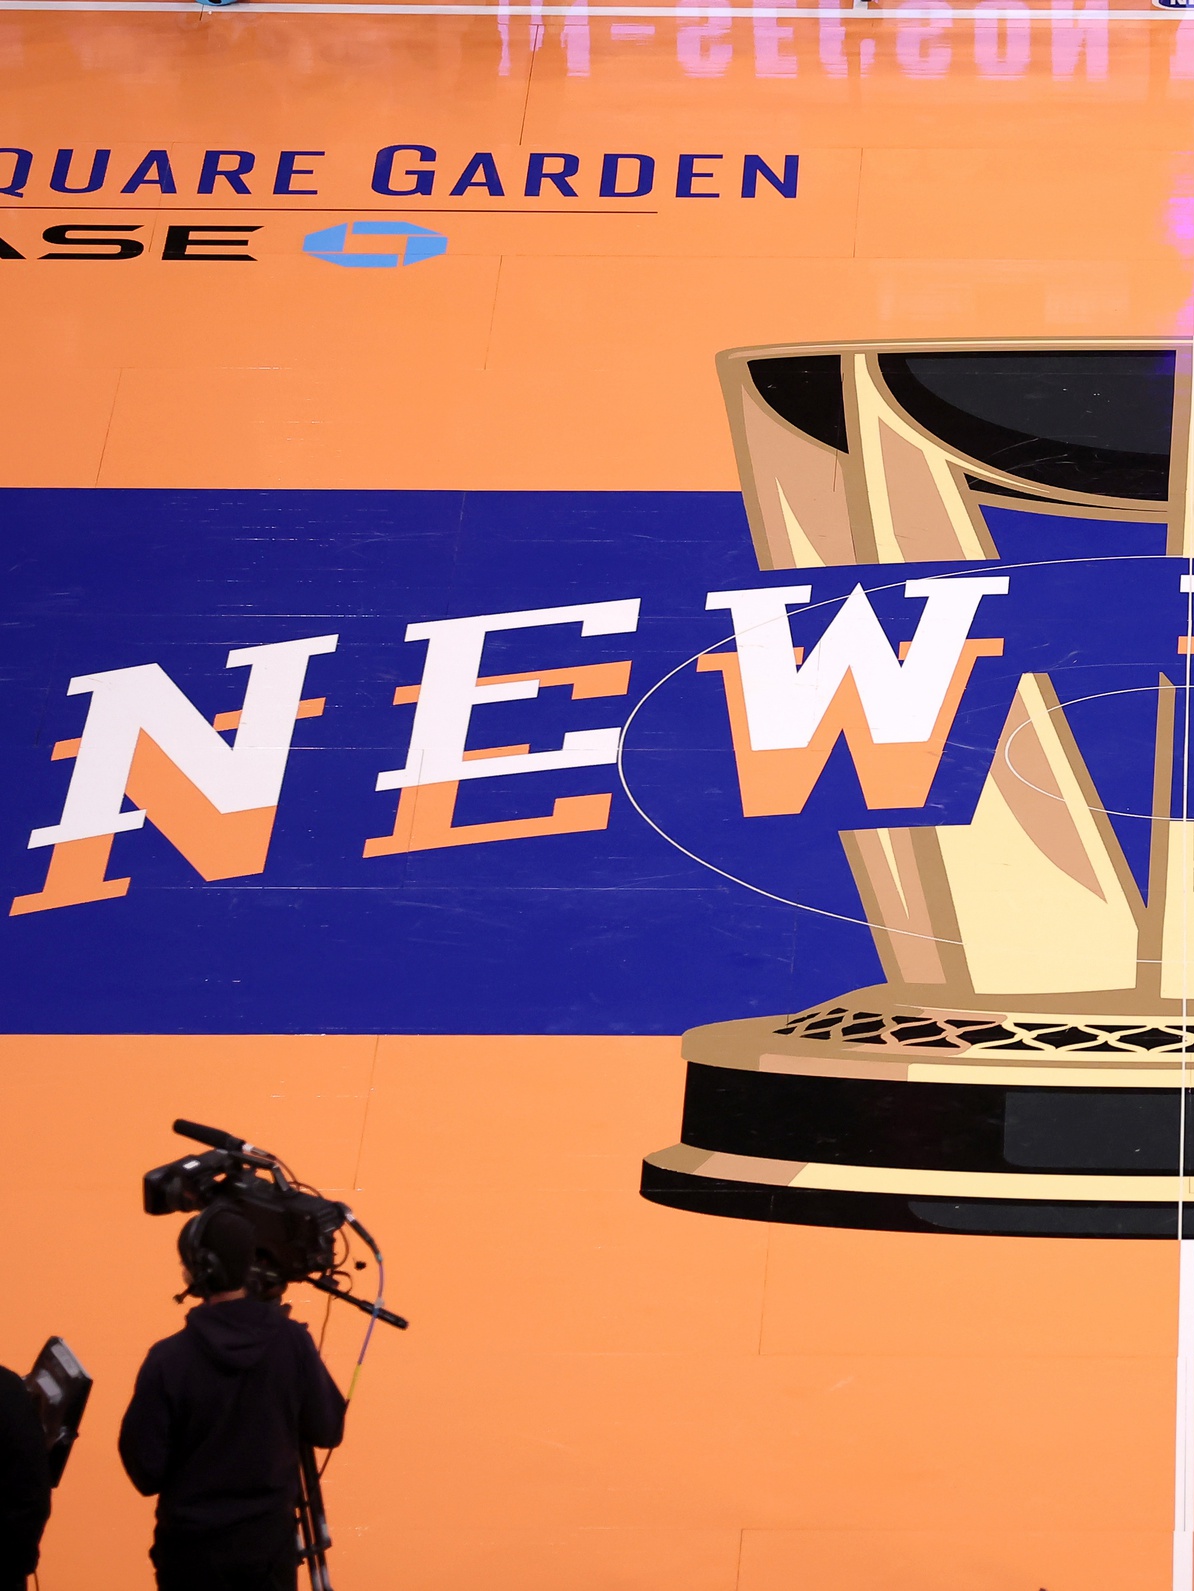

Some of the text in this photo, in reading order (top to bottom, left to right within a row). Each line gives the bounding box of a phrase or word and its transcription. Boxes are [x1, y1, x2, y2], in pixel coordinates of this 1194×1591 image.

[371, 145, 799, 198] GARDEN
[0, 224, 265, 261] SE
[9, 576, 1010, 916] NEW
